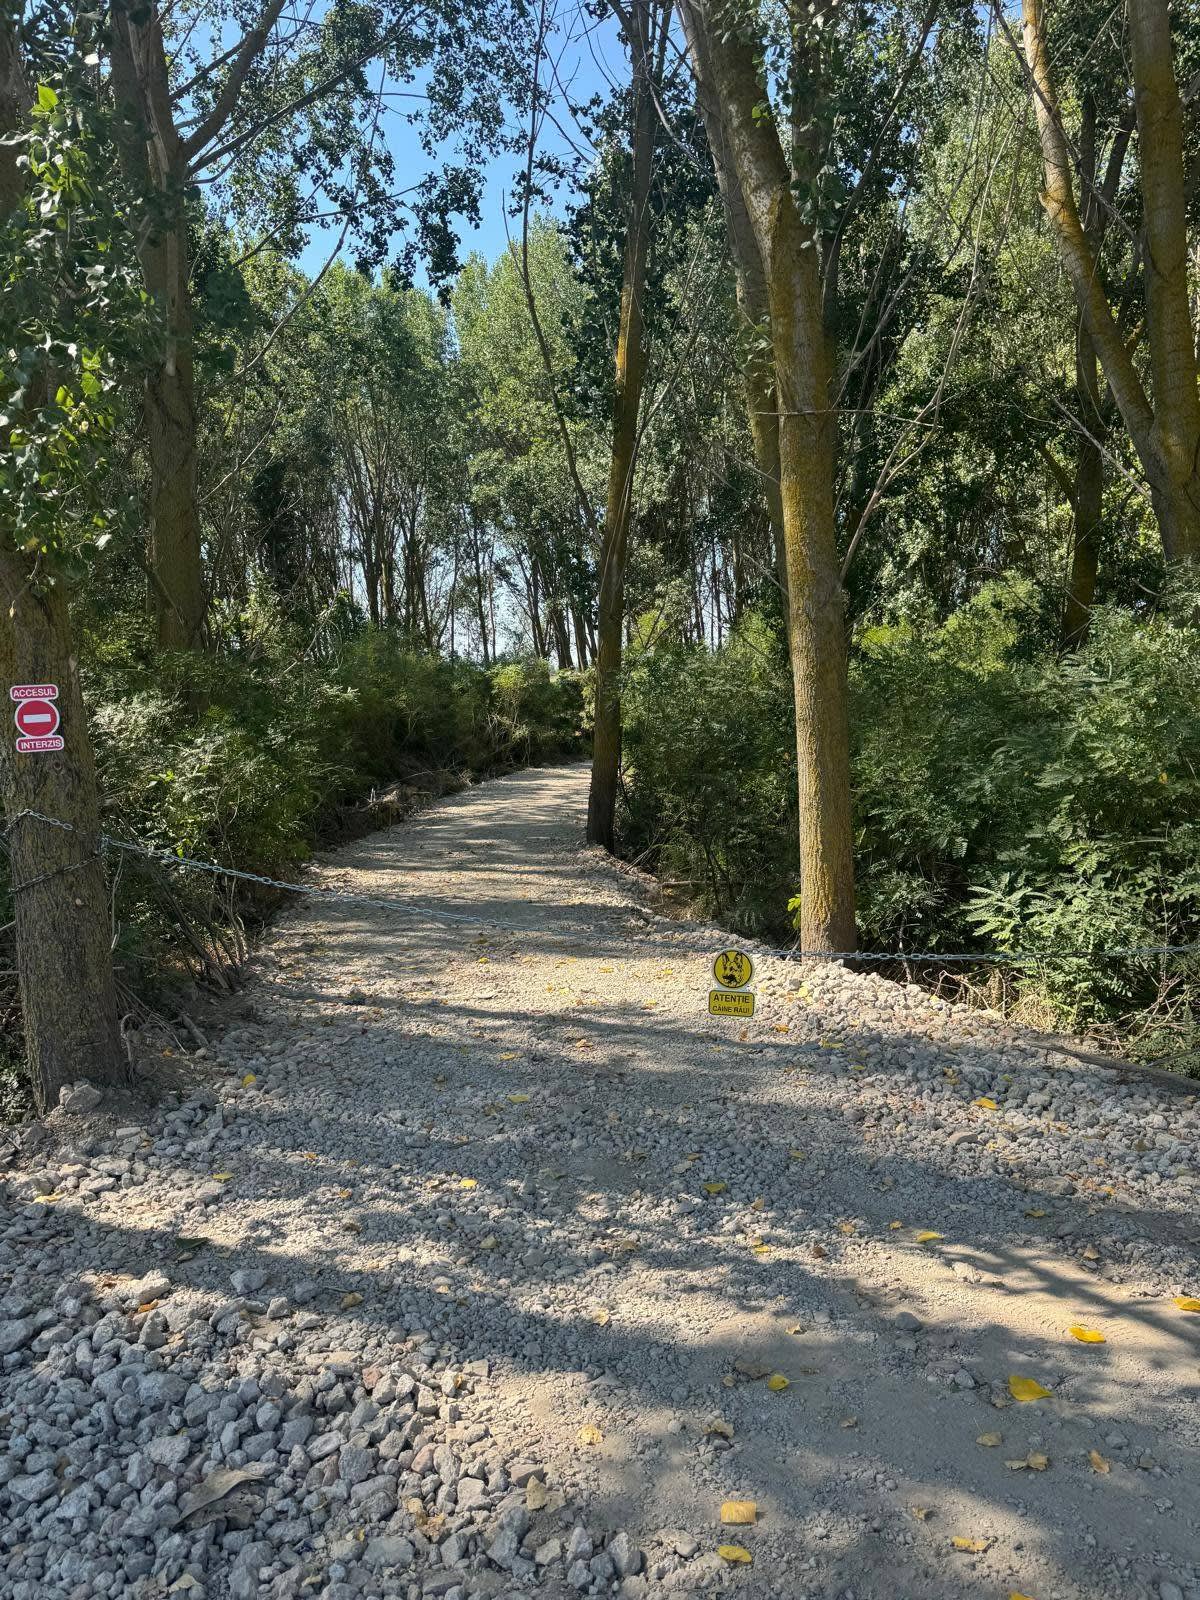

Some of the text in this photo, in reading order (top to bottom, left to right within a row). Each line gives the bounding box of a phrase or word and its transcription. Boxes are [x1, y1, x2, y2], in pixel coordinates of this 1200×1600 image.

[13, 688, 56, 697] ACCESUL
[21, 739, 62, 749] INTERZIS
[713, 993, 750, 1005] ATENȚIE
